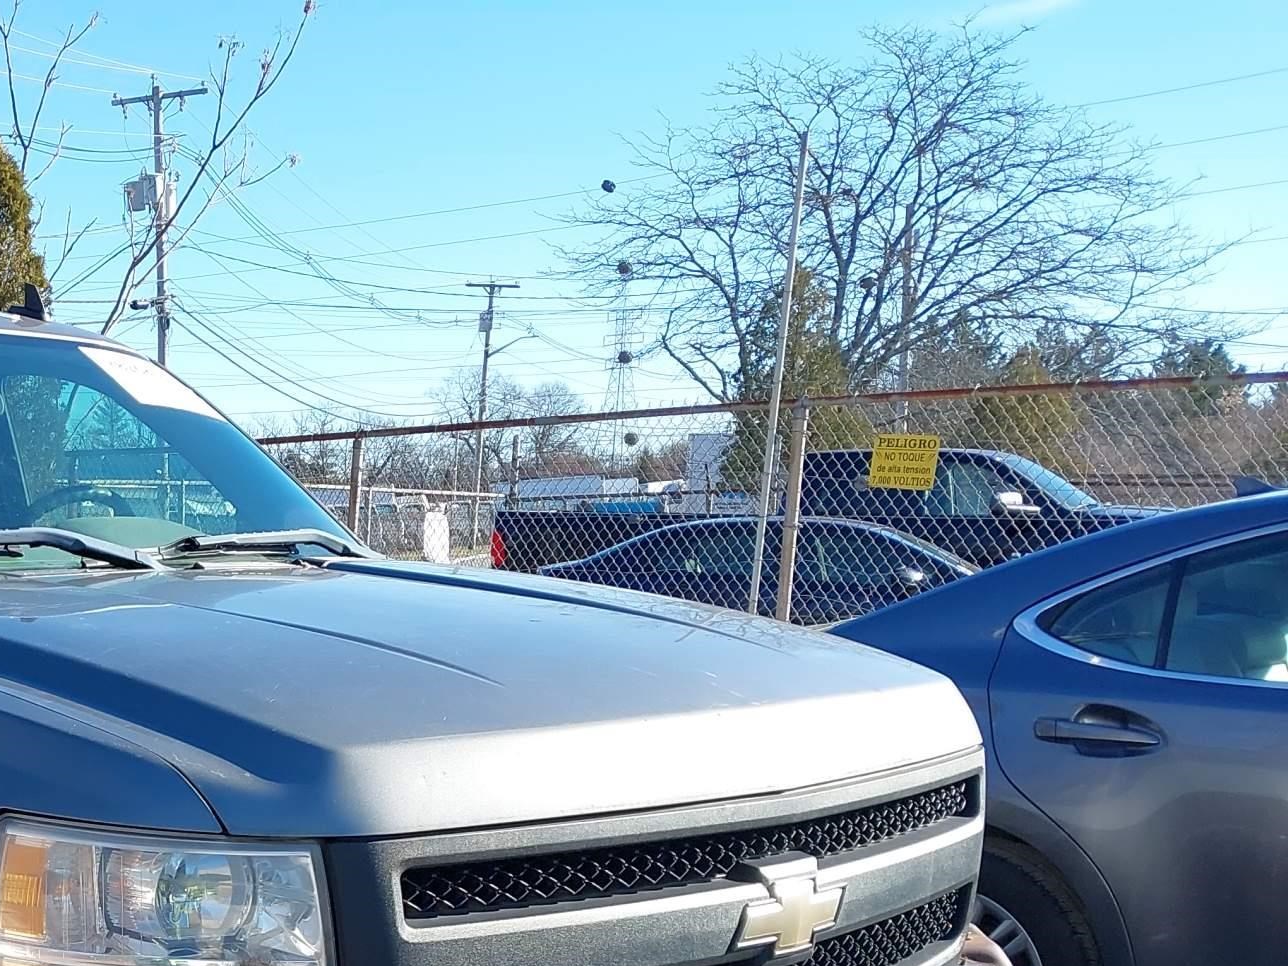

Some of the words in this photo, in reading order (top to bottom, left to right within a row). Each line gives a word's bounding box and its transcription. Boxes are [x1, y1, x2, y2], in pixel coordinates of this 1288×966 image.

[877, 437, 938, 449] PELIGRO
[884, 452, 896, 461] NO
[898, 452, 926, 462] TOQUE
[876, 464, 886, 473] de
[893, 476, 932, 487] VOLTIOS
